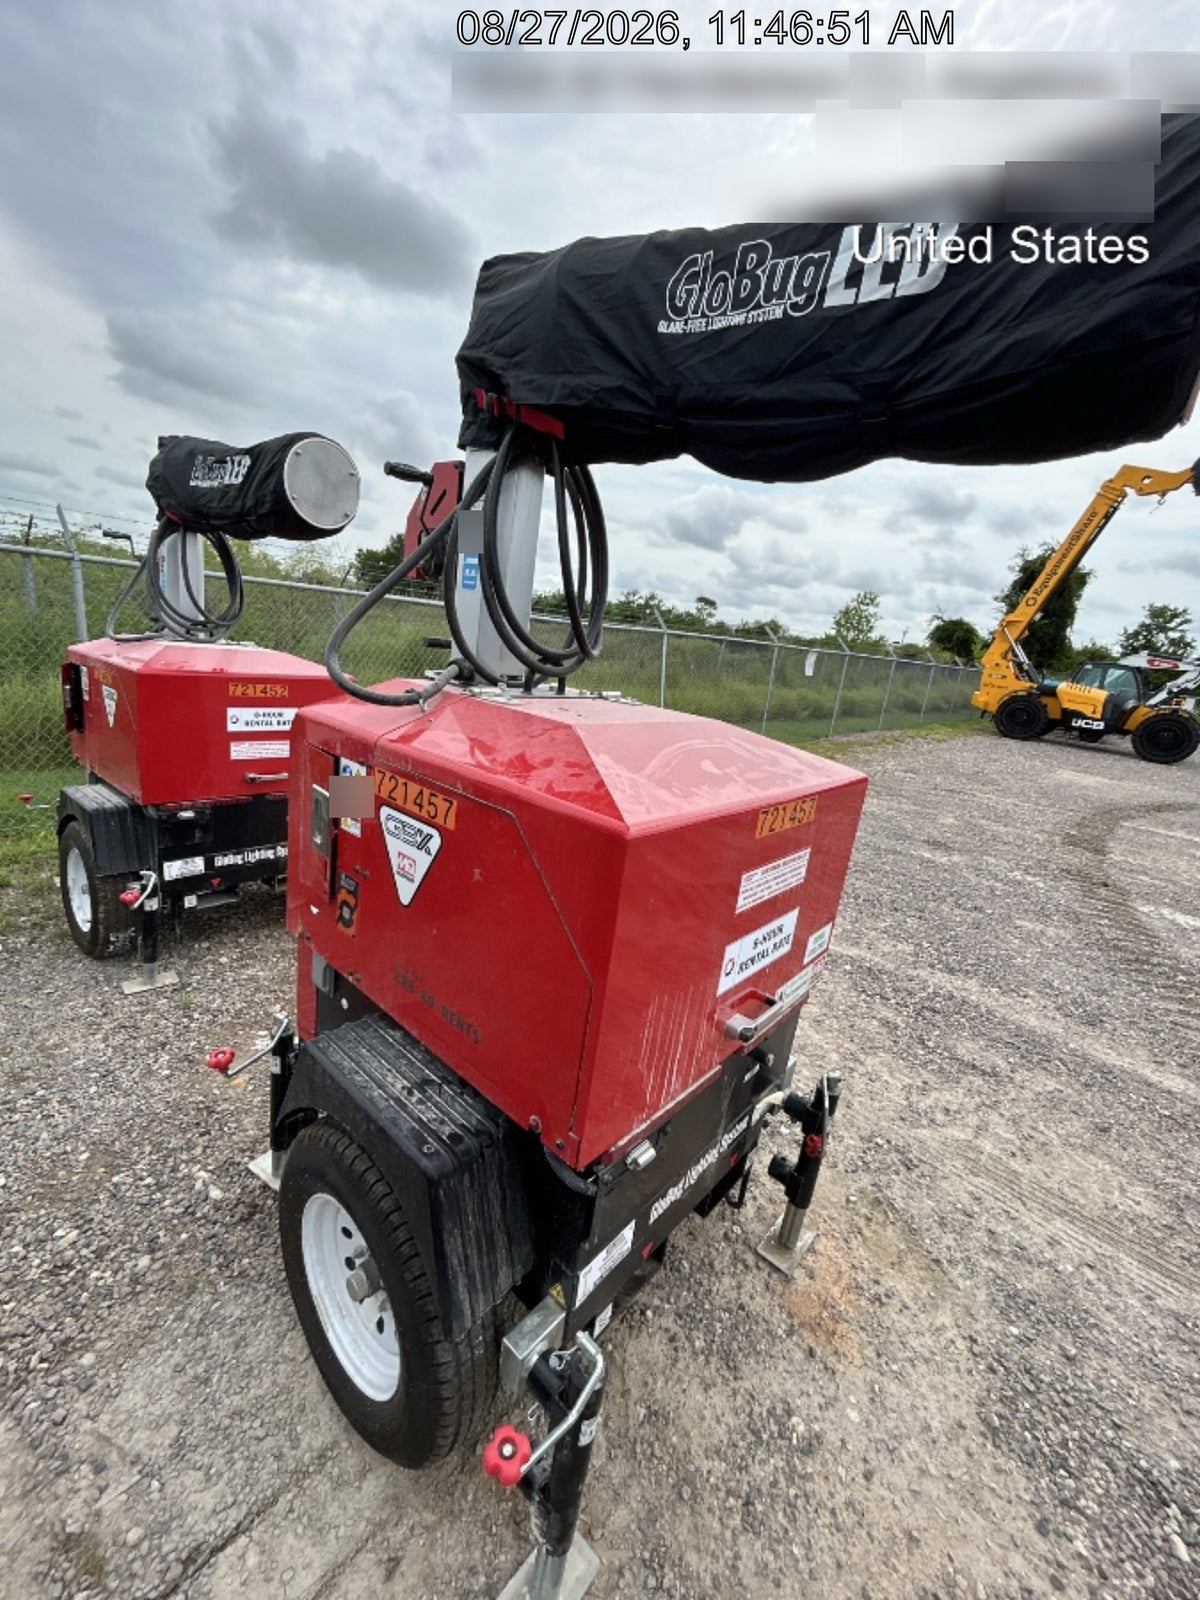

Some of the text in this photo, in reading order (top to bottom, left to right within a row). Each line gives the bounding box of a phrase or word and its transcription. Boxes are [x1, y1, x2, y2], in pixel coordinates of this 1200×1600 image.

[666, 239, 830, 317] GloBug
[230, 684, 288, 697] 721452
[1072, 718, 1105, 730] JCB
[376, 769, 455, 826] 721457
[758, 798, 817, 836] 721457
[737, 948, 771, 975] RENTAL
[770, 933, 792, 955] RATE
